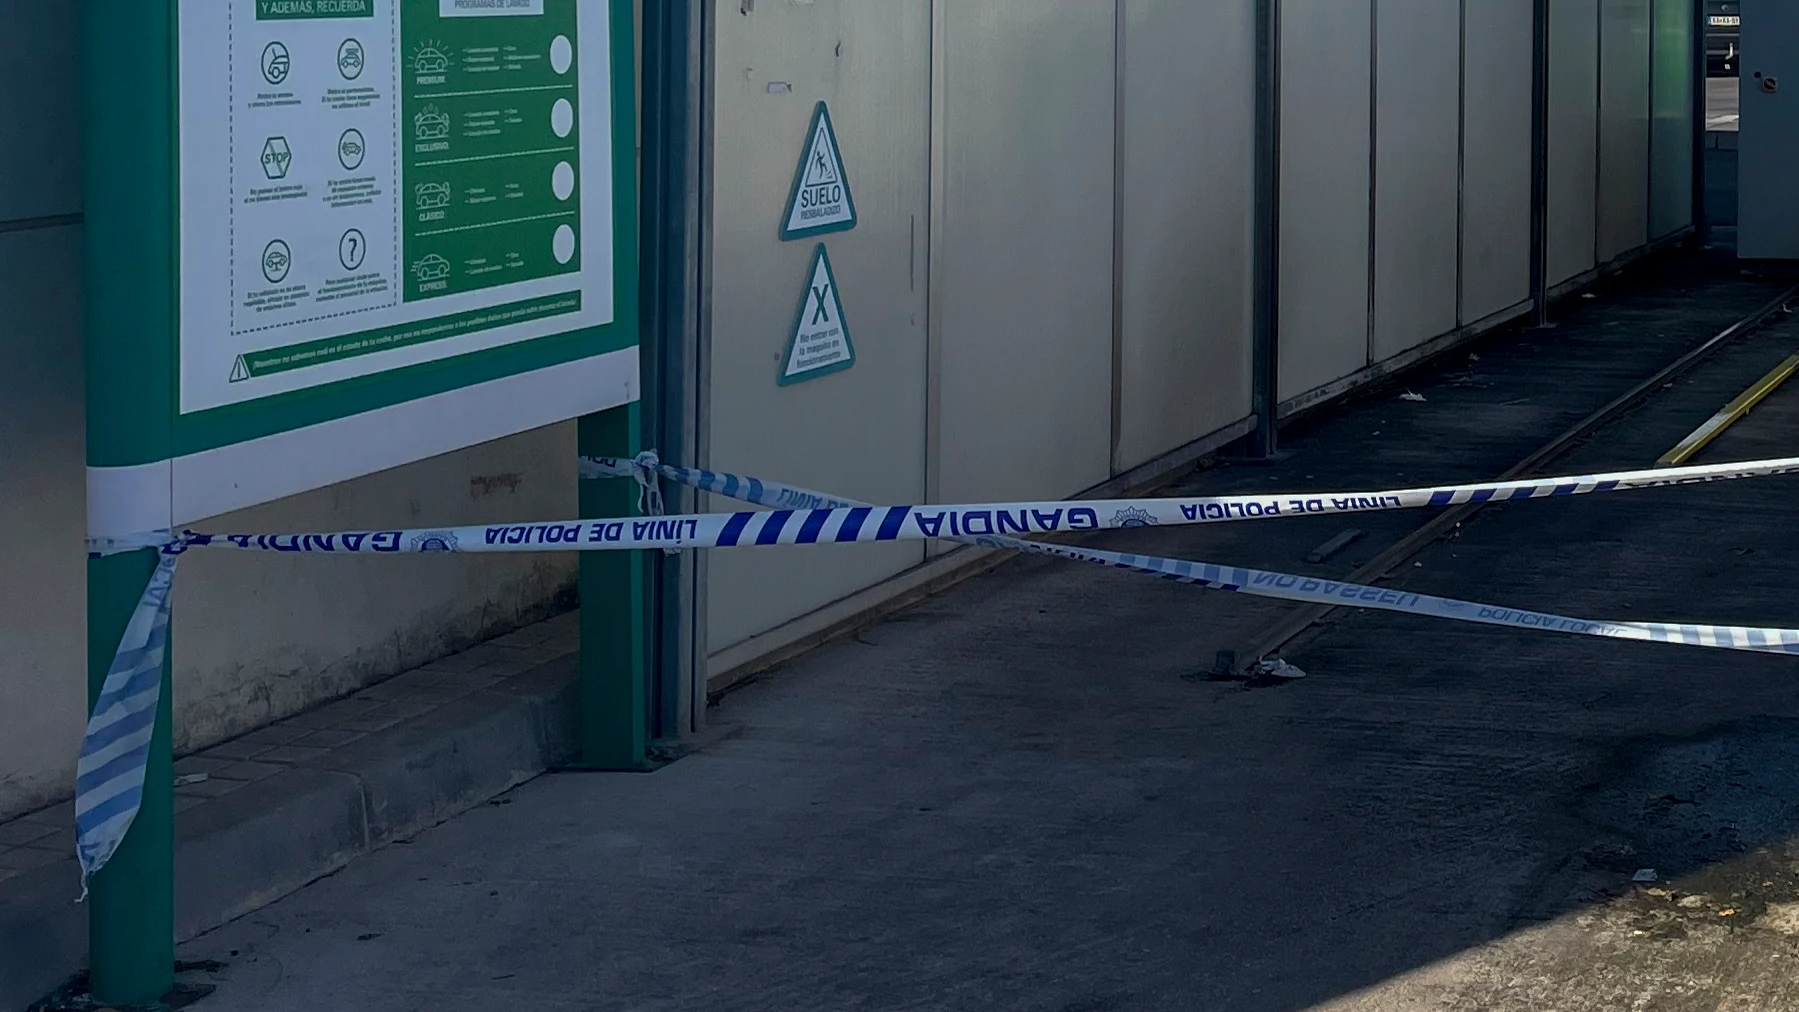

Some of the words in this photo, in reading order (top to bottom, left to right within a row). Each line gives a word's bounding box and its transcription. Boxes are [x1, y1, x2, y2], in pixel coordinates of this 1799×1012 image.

[261, 2, 269, 14] Y
[316, 0, 367, 13] RECUERDA
[454, 0, 496, 9] PROGRAMAS
[264, 152, 289, 164] STOP
[801, 185, 841, 208] SUELO
[1180, 498, 1281, 522] POLICIA
[1290, 497, 1325, 516] DE
[588, 521, 625, 544] DE
[914, 507, 1099, 538] GANDIA
[485, 523, 583, 546] POLICIA
